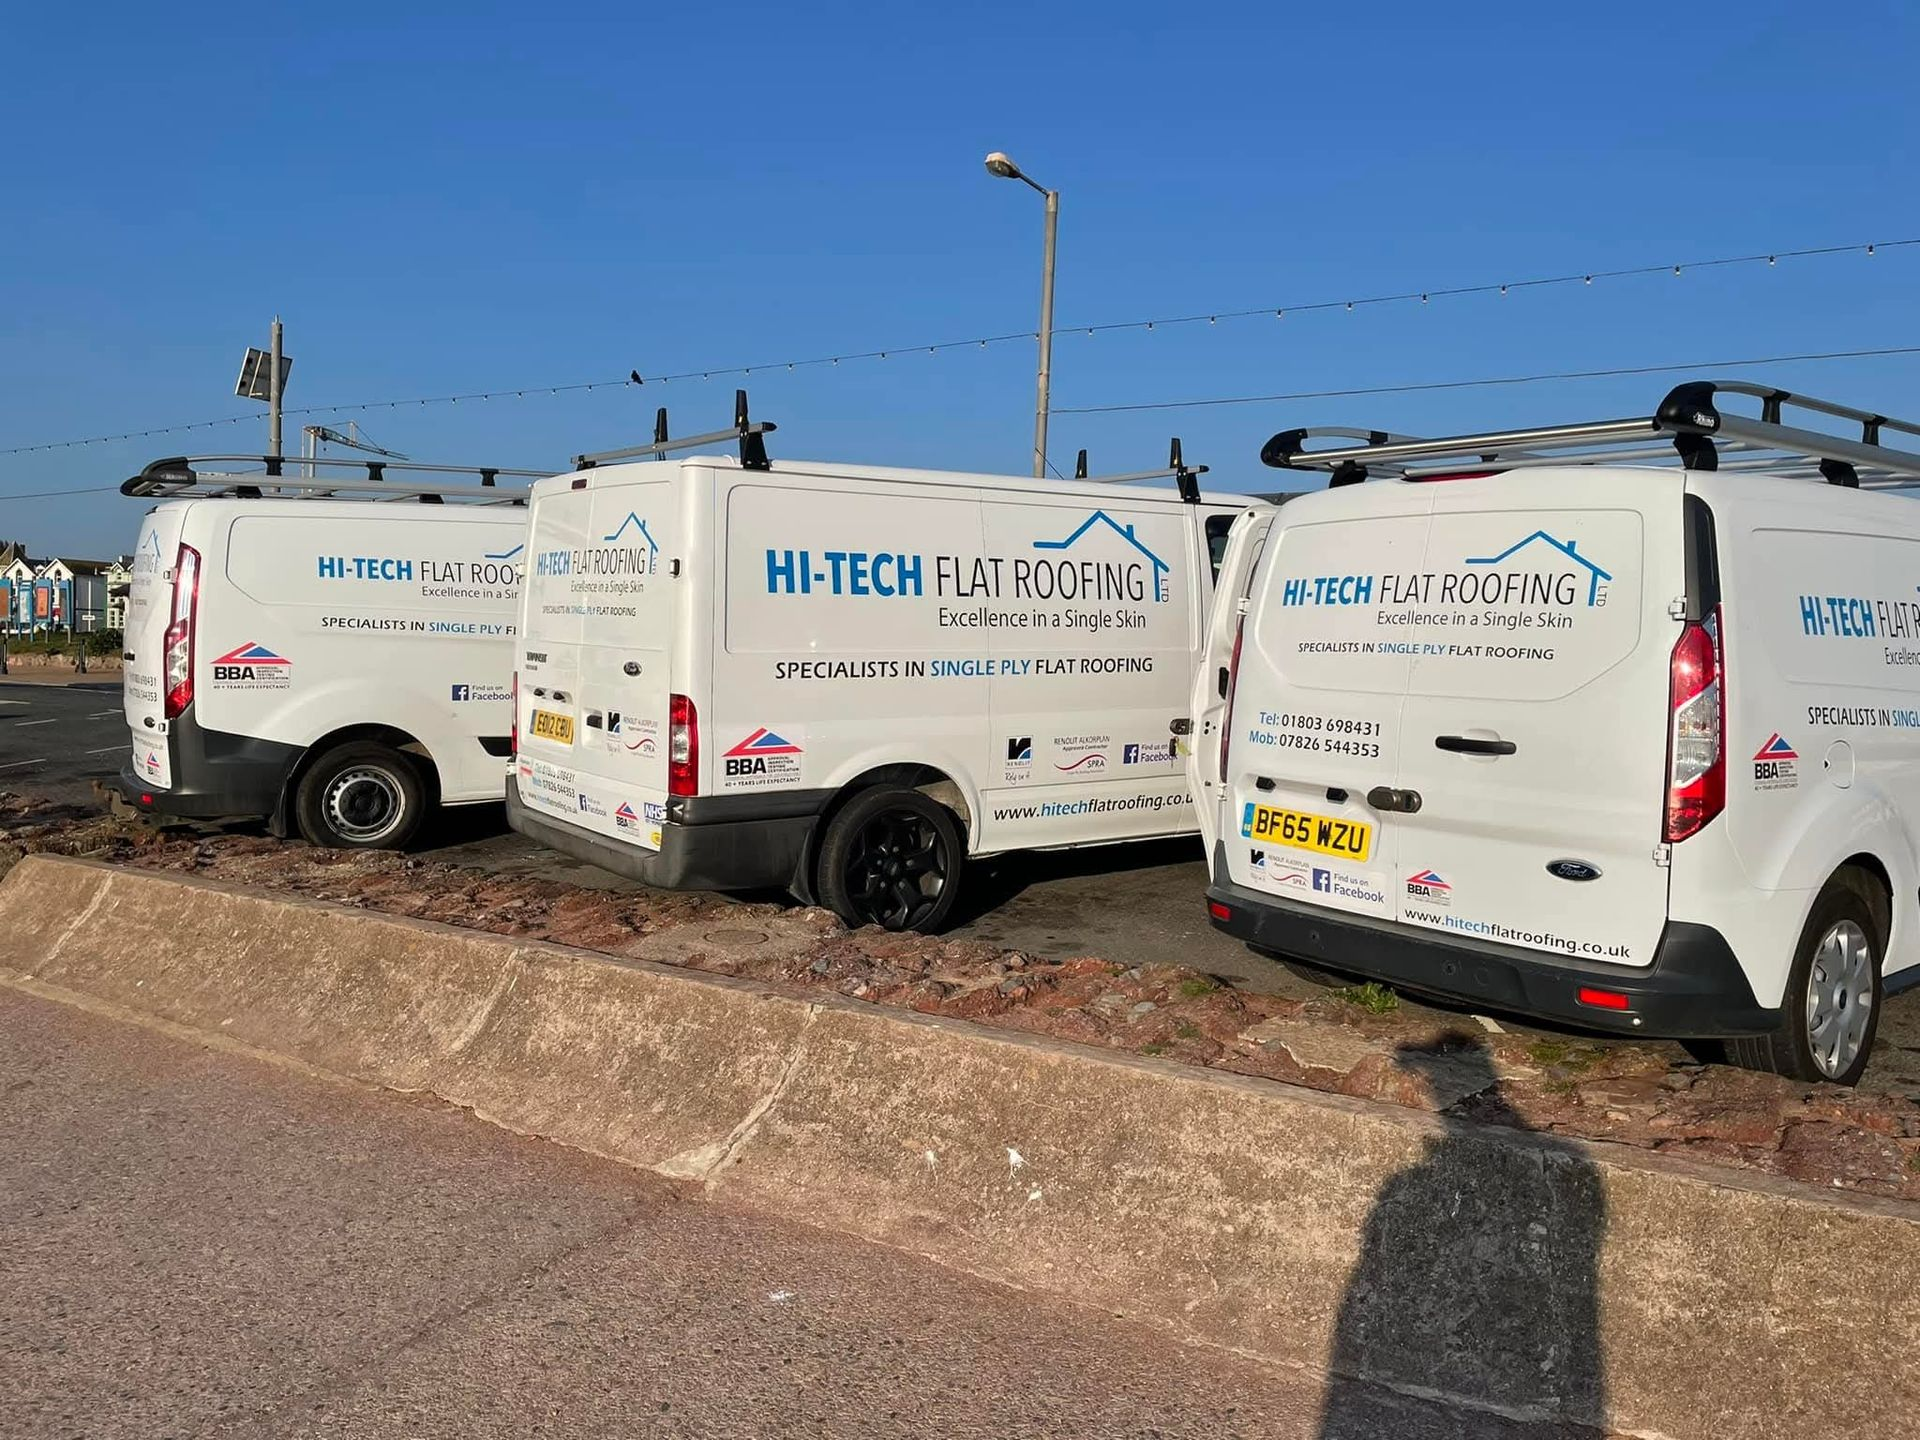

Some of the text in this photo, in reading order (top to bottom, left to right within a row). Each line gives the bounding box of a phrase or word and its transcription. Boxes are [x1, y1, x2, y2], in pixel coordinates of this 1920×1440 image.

[318, 556, 412, 581] HI-TECH
[421, 561, 464, 583] FLAT
[537, 550, 571, 576] HI-TECH
[572, 550, 593, 574] FLAT
[594, 548, 645, 574] ROOFING
[766, 549, 1144, 601] HI-TECH FLAT ROOFING
[422, 586, 480, 598] Excellence
[483, 589, 493, 598] in
[1160, 578, 1170, 604] LTD
[1283, 573, 1577, 606] HI-TECH FLAT ROOFING
[1597, 585, 1608, 607] LTD
[322, 616, 406, 631] SPECIALISTS
[410, 620, 425, 632] IN
[429, 622, 476, 633] SINGLE
[480, 624, 502, 635] PLY
[939, 607, 1146, 633] Excellence in a Single Skin
[1377, 611, 1573, 631] Excellence in a Single Skin
[1800, 596, 1875, 637] HI-TECH
[1877, 600, 1910, 638] FLAT
[1298, 642, 1554, 660] SPECIALISTS IN SINGLE PLY FLAT ROOFING
[214, 666, 255, 680] BBA
[776, 657, 1153, 680] SPECIALISTS IN SINGLE PLY FLAT ROOFING
[1260, 711, 1380, 737] Tel: 01803 698431
[1808, 706, 1876, 726] SPECIALISTS
[1878, 708, 1890, 727] IN
[1249, 730, 1379, 758] Mob: 07826 544353
[726, 758, 767, 776] BBA
[1087, 760, 1105, 768] SPRA
[1755, 763, 1778, 779] BBA
[1256, 808, 1365, 854] BF65 WZU
[1334, 873, 1348, 882] Find
[1559, 863, 1588, 876] Ford
[1334, 884, 1385, 904] Facebook
[1408, 884, 1430, 896] BBA
[1404, 908, 1630, 958] www.hitechflatroofing.co.uk
